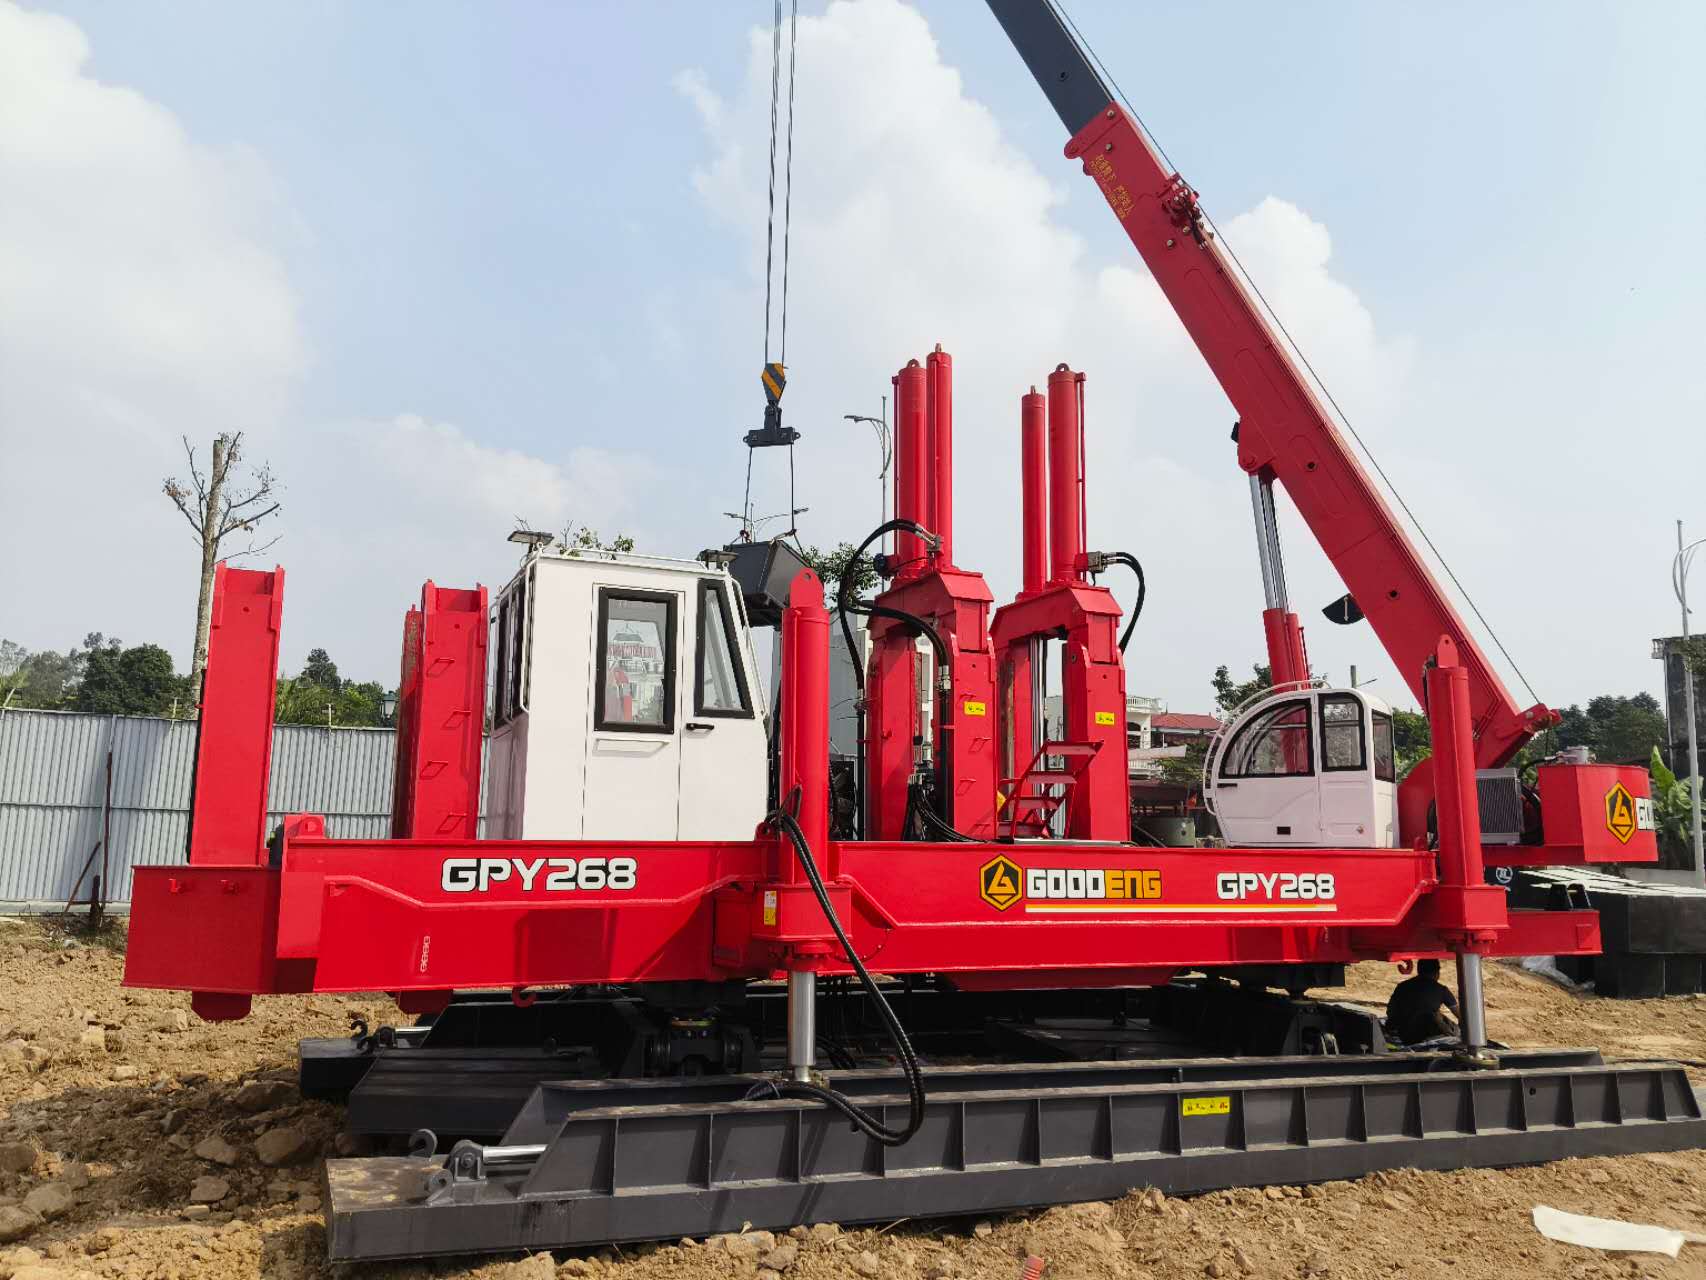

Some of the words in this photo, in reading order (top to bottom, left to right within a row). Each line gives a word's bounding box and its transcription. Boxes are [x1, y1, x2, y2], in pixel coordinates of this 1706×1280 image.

[441, 857, 638, 892] GPY268
[1025, 868, 1162, 899] GOODENG
[1216, 872, 1336, 900] GPY268
